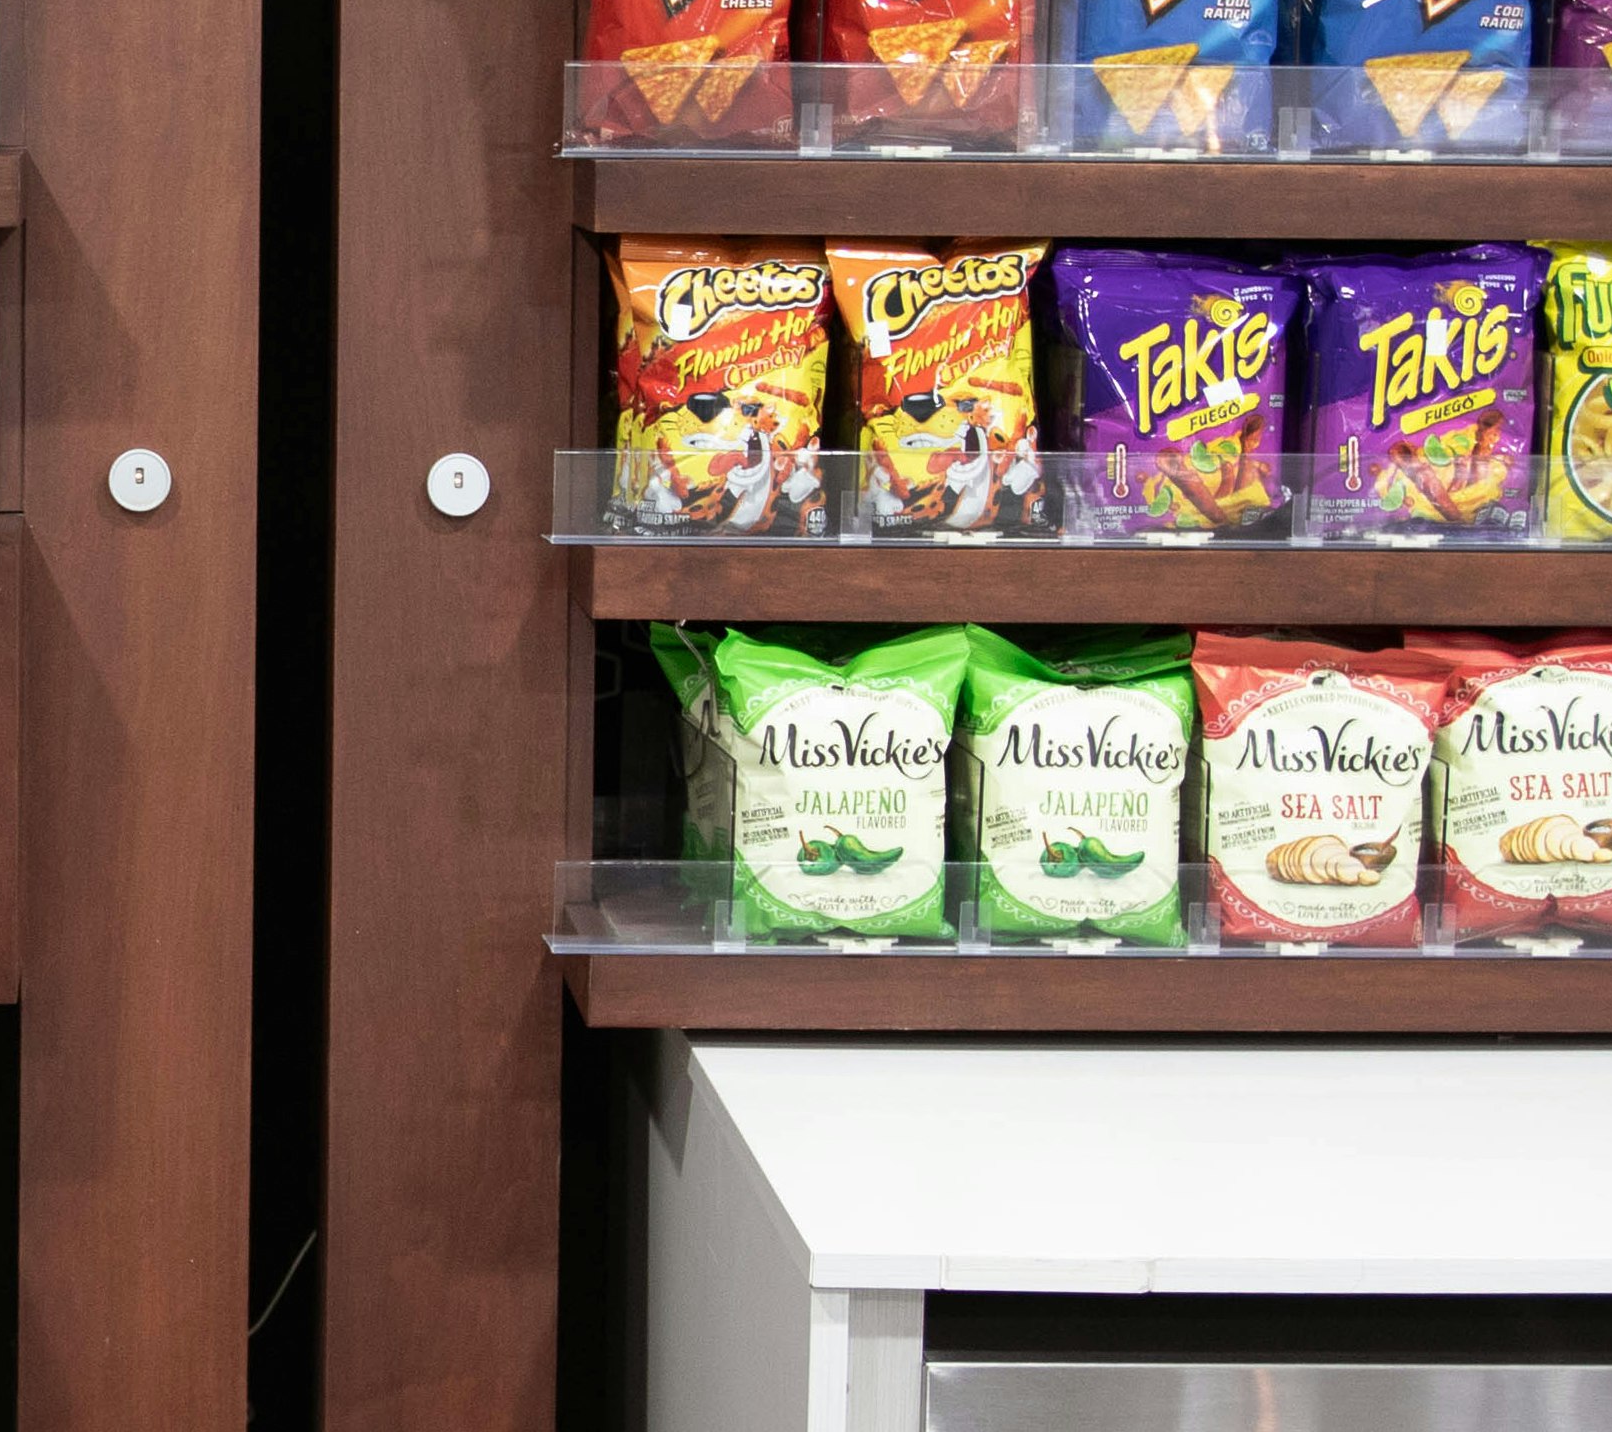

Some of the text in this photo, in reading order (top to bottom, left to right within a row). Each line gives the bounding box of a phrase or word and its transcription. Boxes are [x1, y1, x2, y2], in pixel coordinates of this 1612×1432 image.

[1203, 7, 1251, 21] RANCH
[658, 262, 827, 338] Cheetos
[867, 253, 1027, 337] Cheetos
[1121, 312, 1271, 433] Takis
[759, 712, 945, 781] Miss Vickie's
[1510, 771, 1612, 801] SEA SALT
[795, 787, 907, 816] JALAPEÑO
[1039, 789, 1149, 816] JALAPEÑO
[1280, 793, 1382, 819] SEA SALT
[855, 815, 907, 830] FLAVORED
[1098, 818, 1149, 834] FLAVORED
